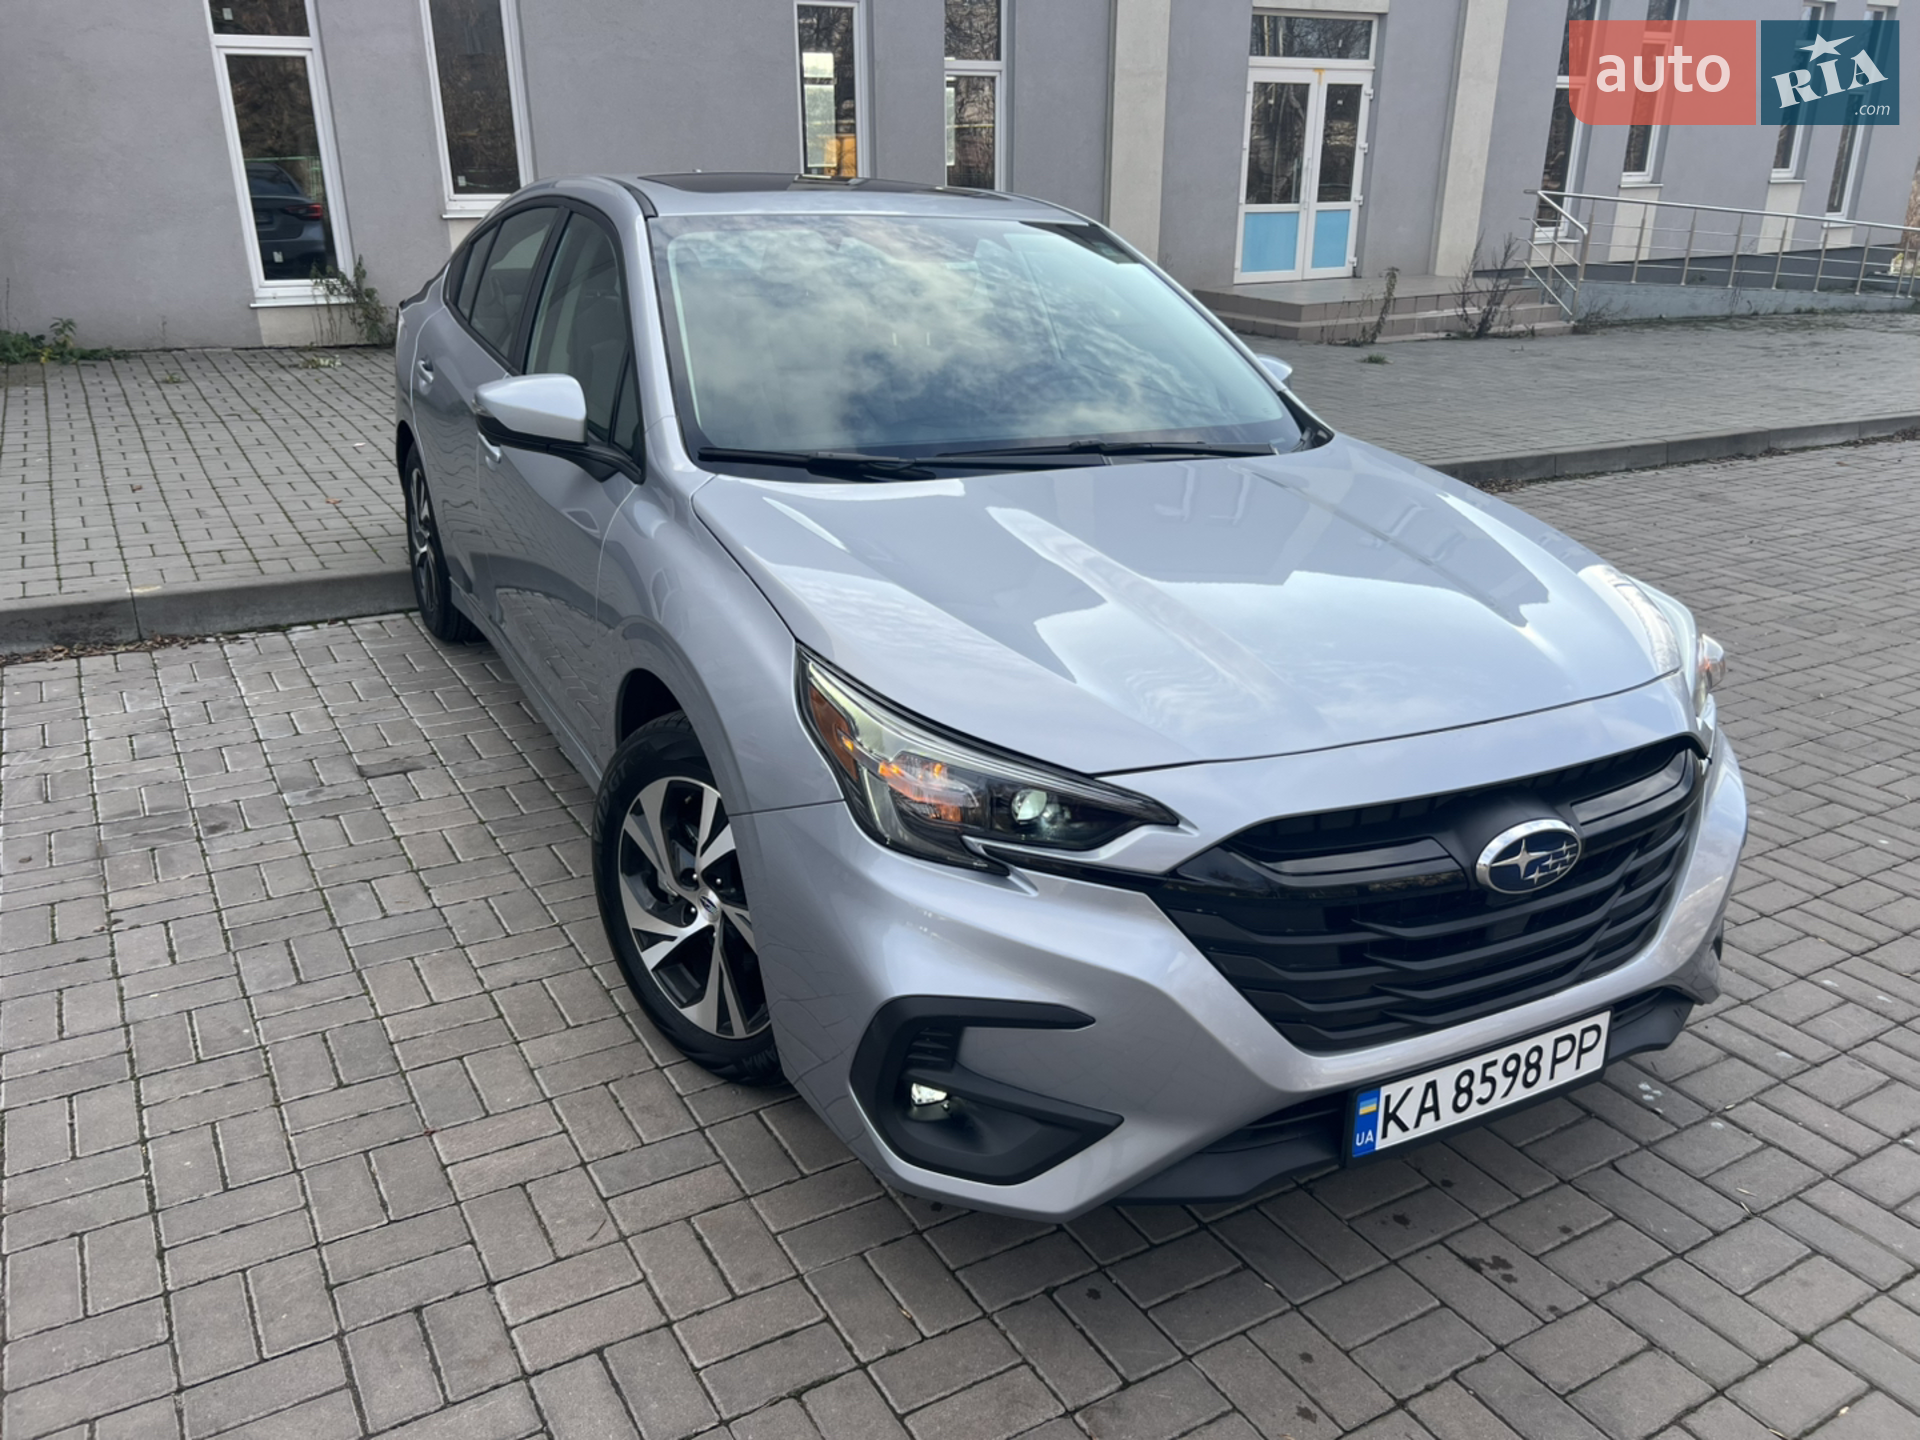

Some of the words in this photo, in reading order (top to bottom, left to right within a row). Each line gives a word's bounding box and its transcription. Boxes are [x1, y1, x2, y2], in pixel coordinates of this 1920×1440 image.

[1381, 1079, 1441, 1140] KA
[1451, 1045, 1544, 1114] 8598
[1549, 1023, 1601, 1081] PP
[1355, 1129, 1375, 1147] UA
